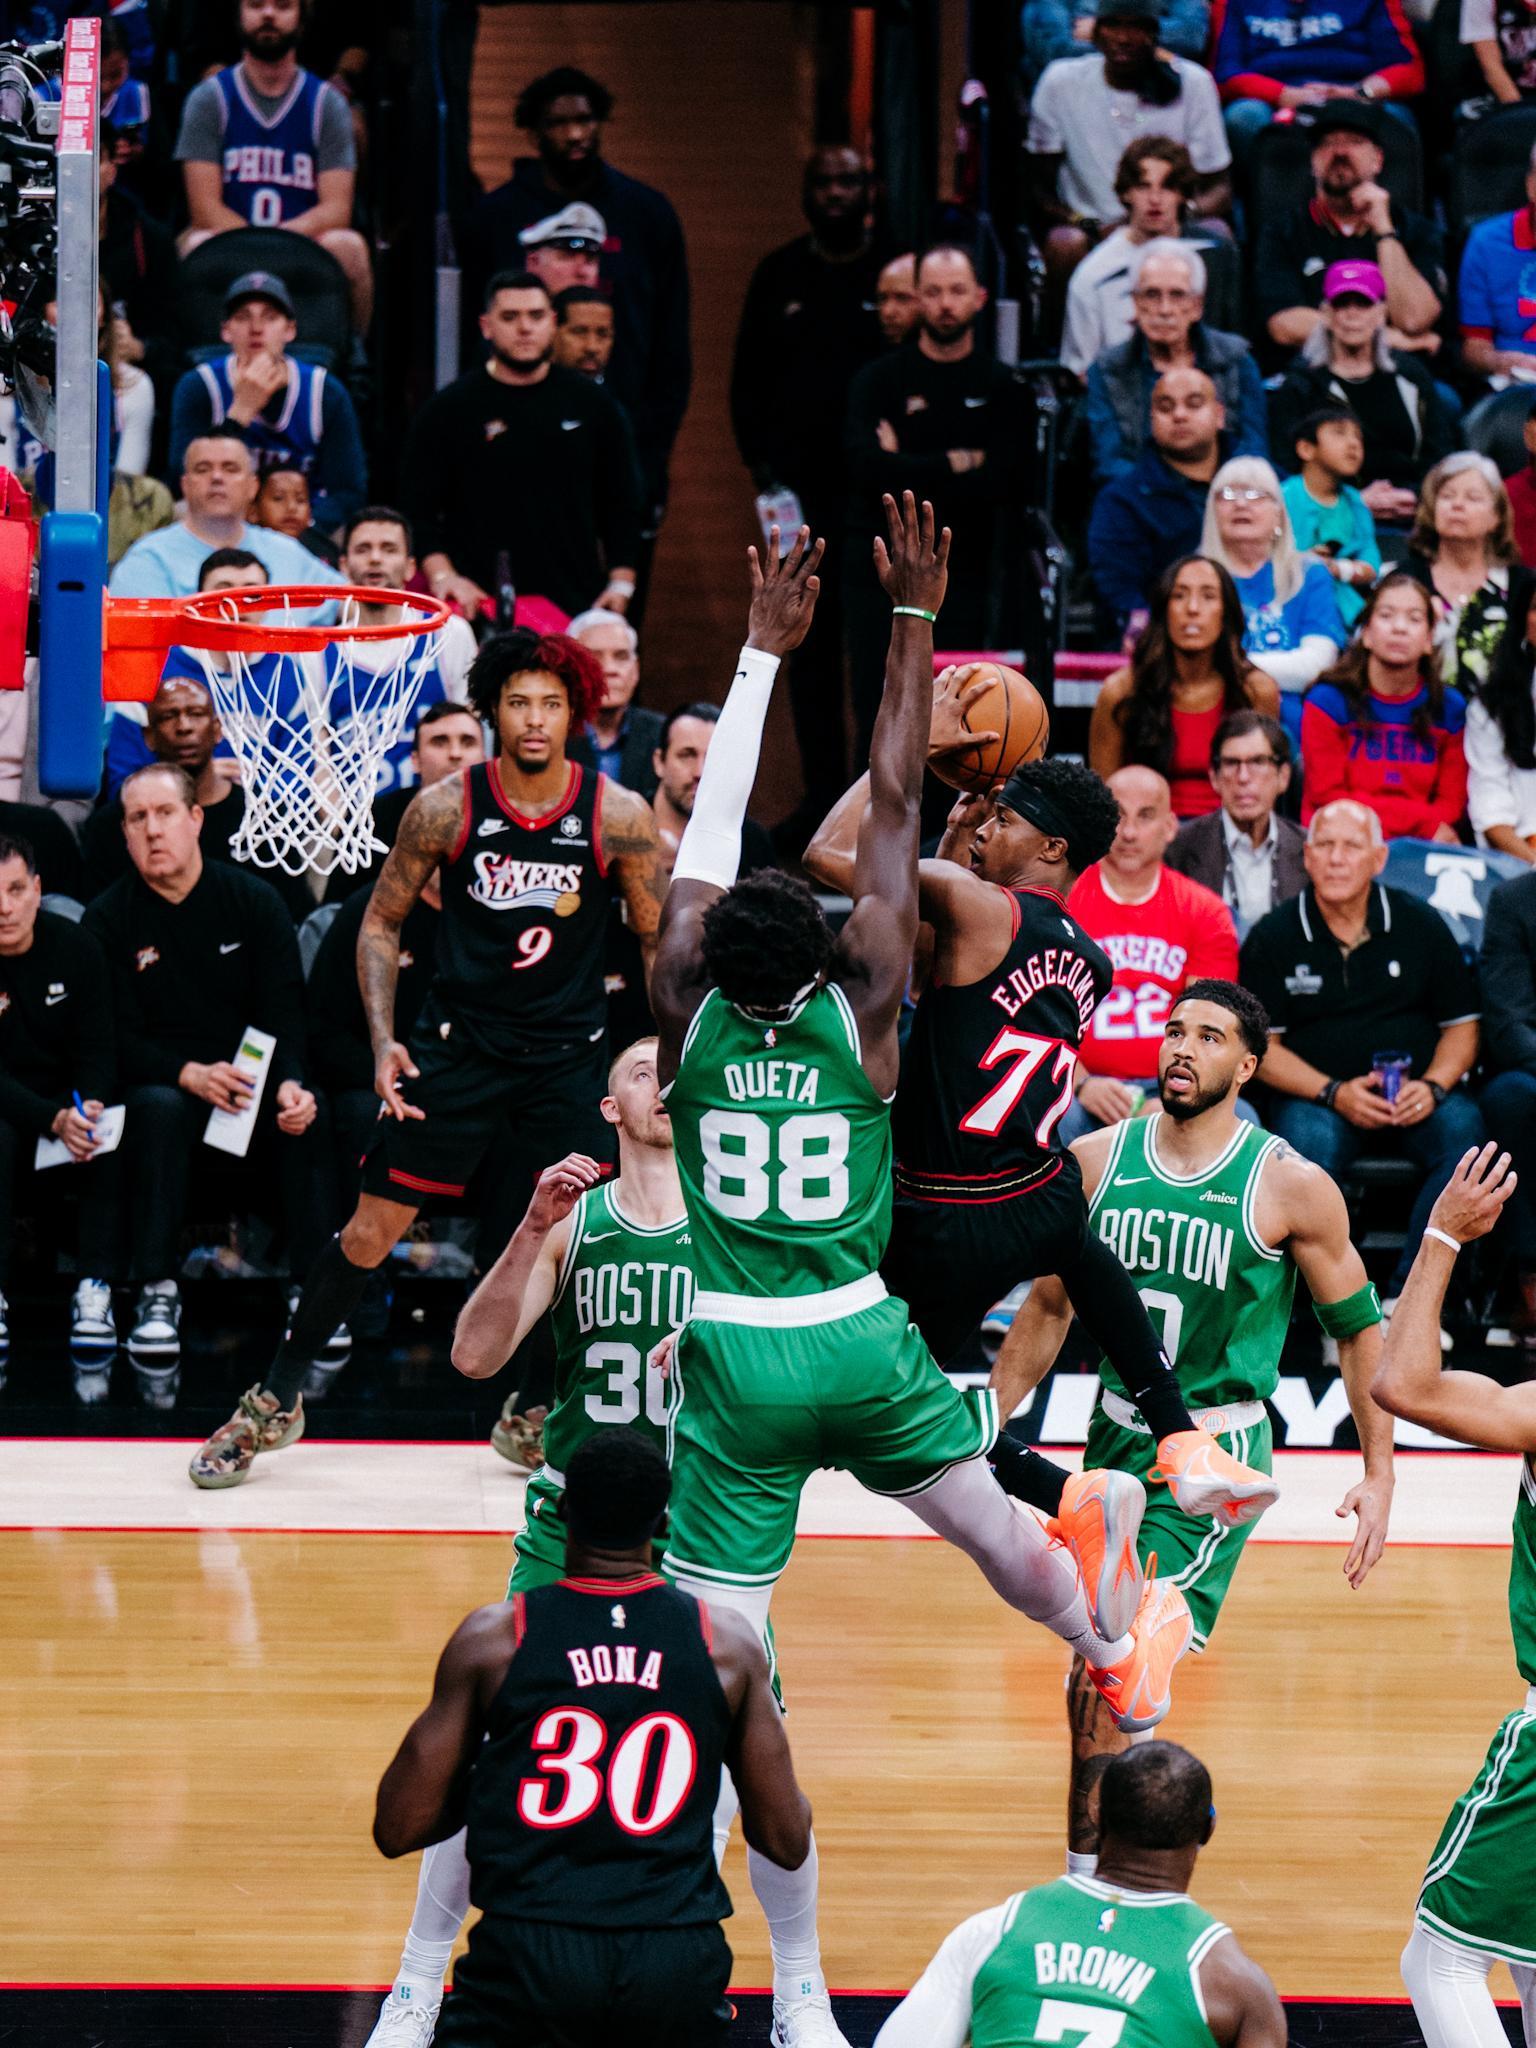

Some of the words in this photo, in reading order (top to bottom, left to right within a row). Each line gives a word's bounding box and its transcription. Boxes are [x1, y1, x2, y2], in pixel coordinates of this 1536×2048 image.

[223, 146, 314, 190] PHILA
[252, 188, 282, 227] 0
[1349, 728, 1436, 764] 76ERS
[511, 925, 554, 969] 9
[1094, 982, 1172, 1040] 22
[723, 1060, 820, 1106] QUETA
[959, 1025, 1079, 1148] 77
[699, 1109, 850, 1222] 88
[1199, 1190, 1238, 1205] Amica
[1099, 1207, 1235, 1292] BOSTON
[567, 1645, 663, 1691] BONA
[516, 1705, 698, 1836] 30
[1034, 1941, 1157, 2006] BROWN
[1033, 1998, 1128, 2048] 7
